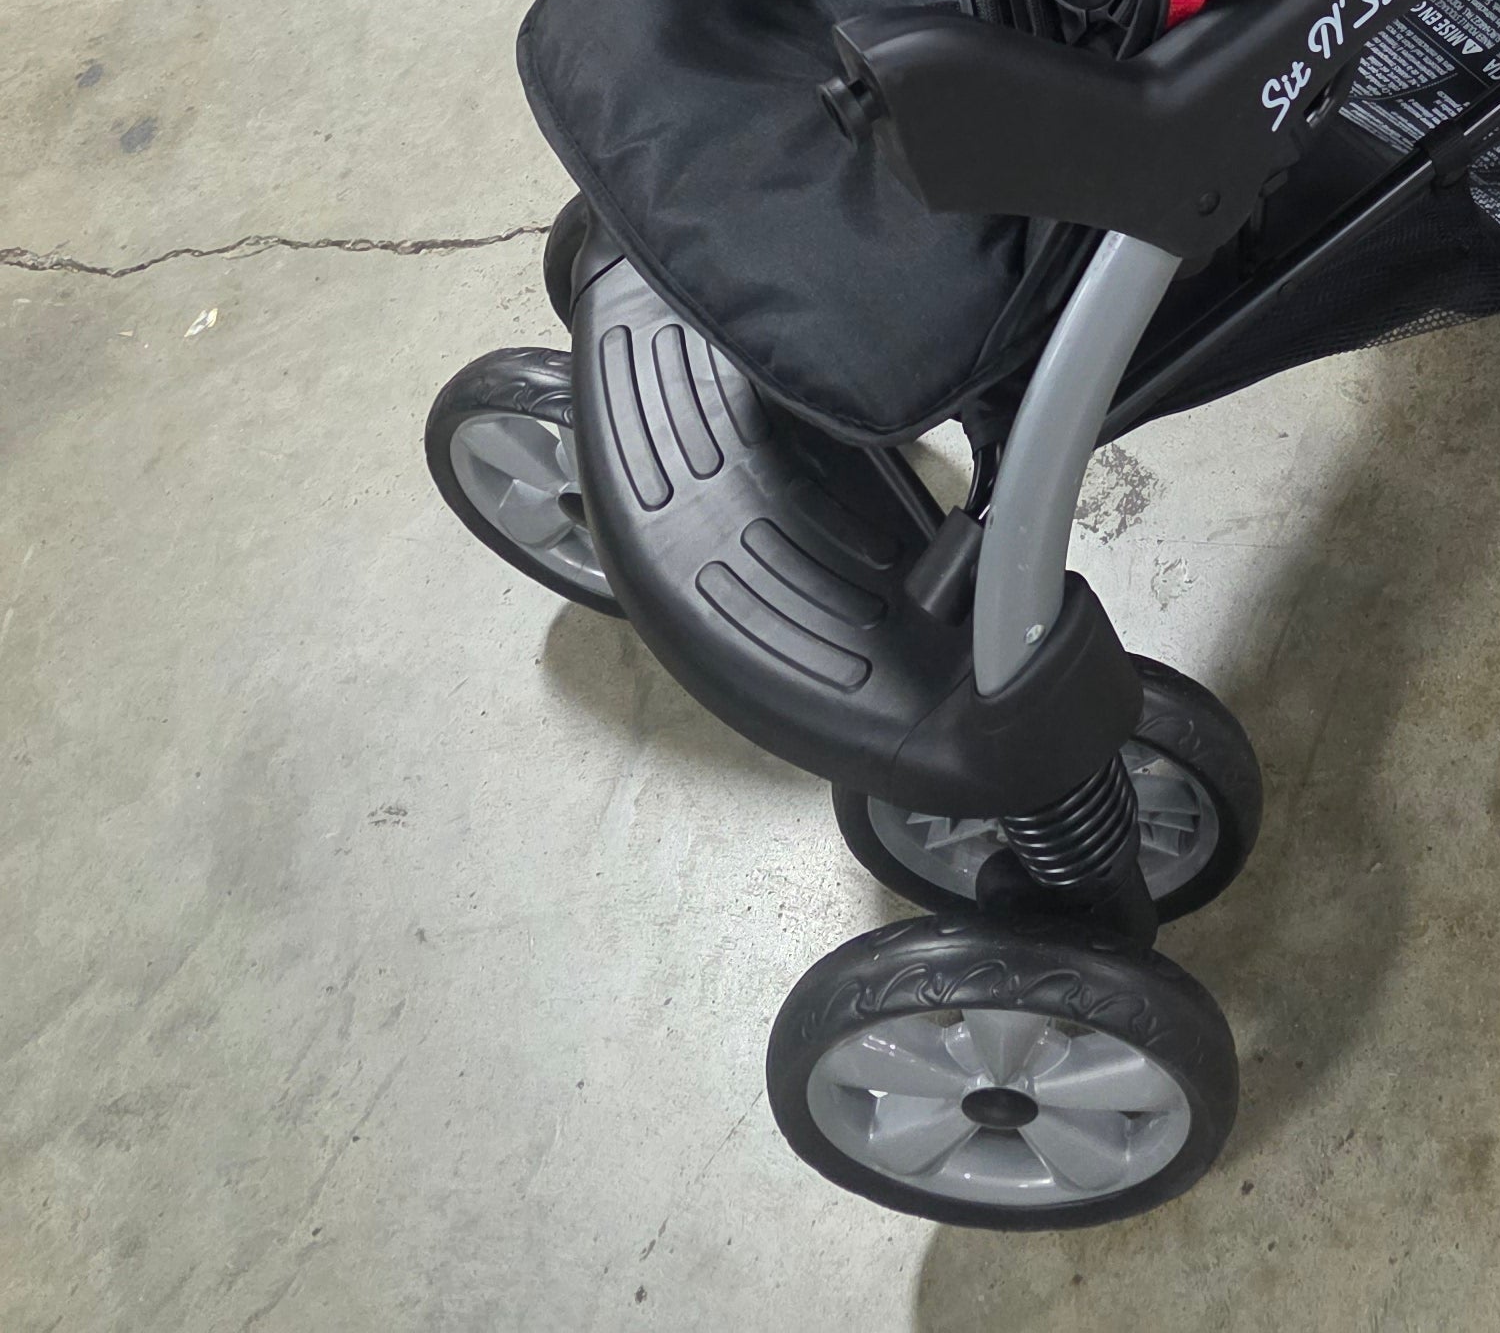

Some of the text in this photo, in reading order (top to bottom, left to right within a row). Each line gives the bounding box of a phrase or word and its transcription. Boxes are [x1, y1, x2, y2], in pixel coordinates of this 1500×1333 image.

[1417, 5, 1468, 47] MISE EN
[1261, 59, 1312, 132] Sit
